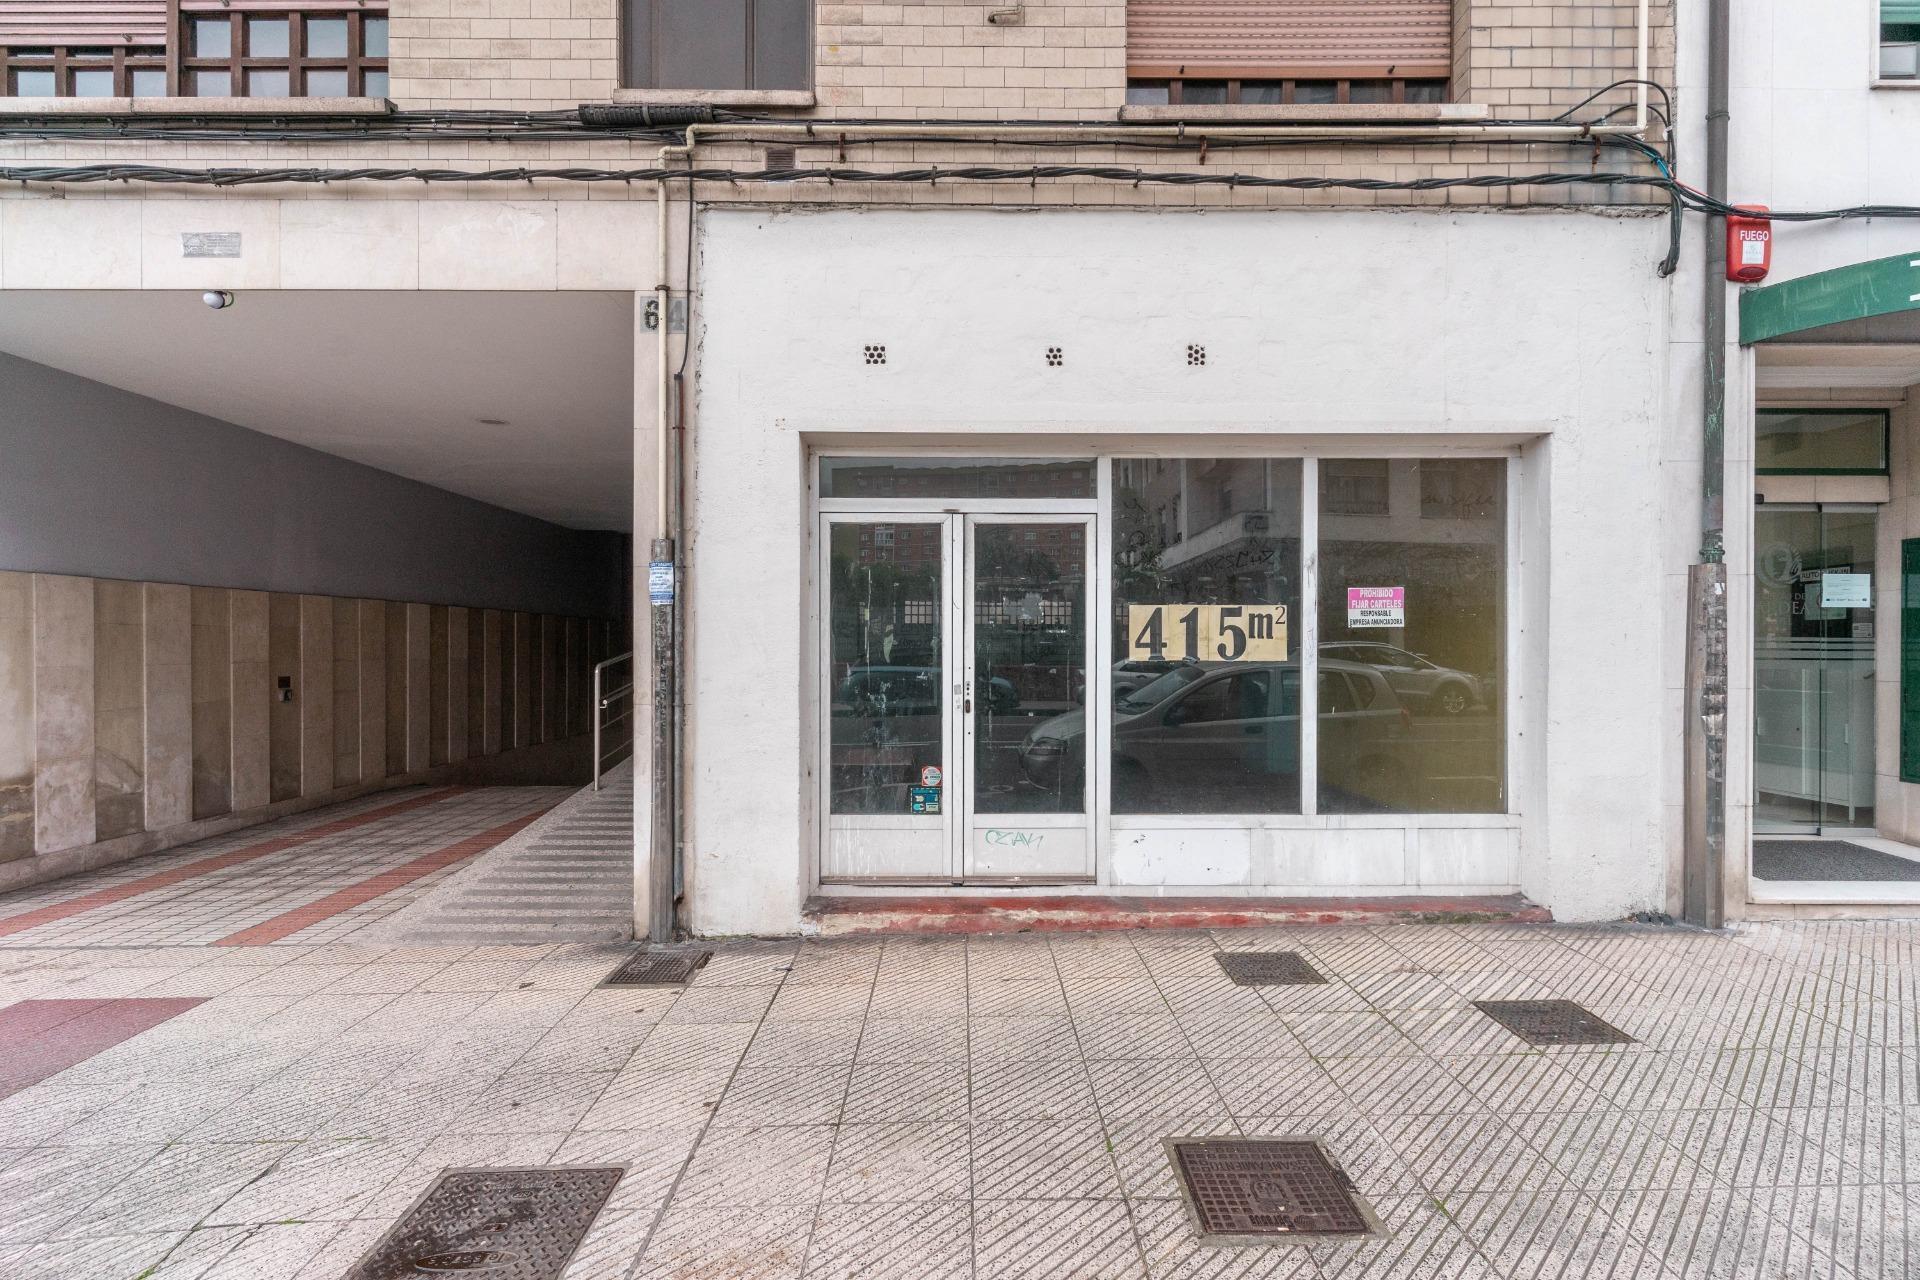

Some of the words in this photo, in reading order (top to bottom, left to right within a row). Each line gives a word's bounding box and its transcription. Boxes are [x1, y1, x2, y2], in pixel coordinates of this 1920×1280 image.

[1740, 230, 1769, 241] FUEGO
[1359, 589, 1393, 598] PROHIBIDO
[1351, 600, 1369, 608] FIJAR
[1370, 600, 1402, 608] CARTELES
